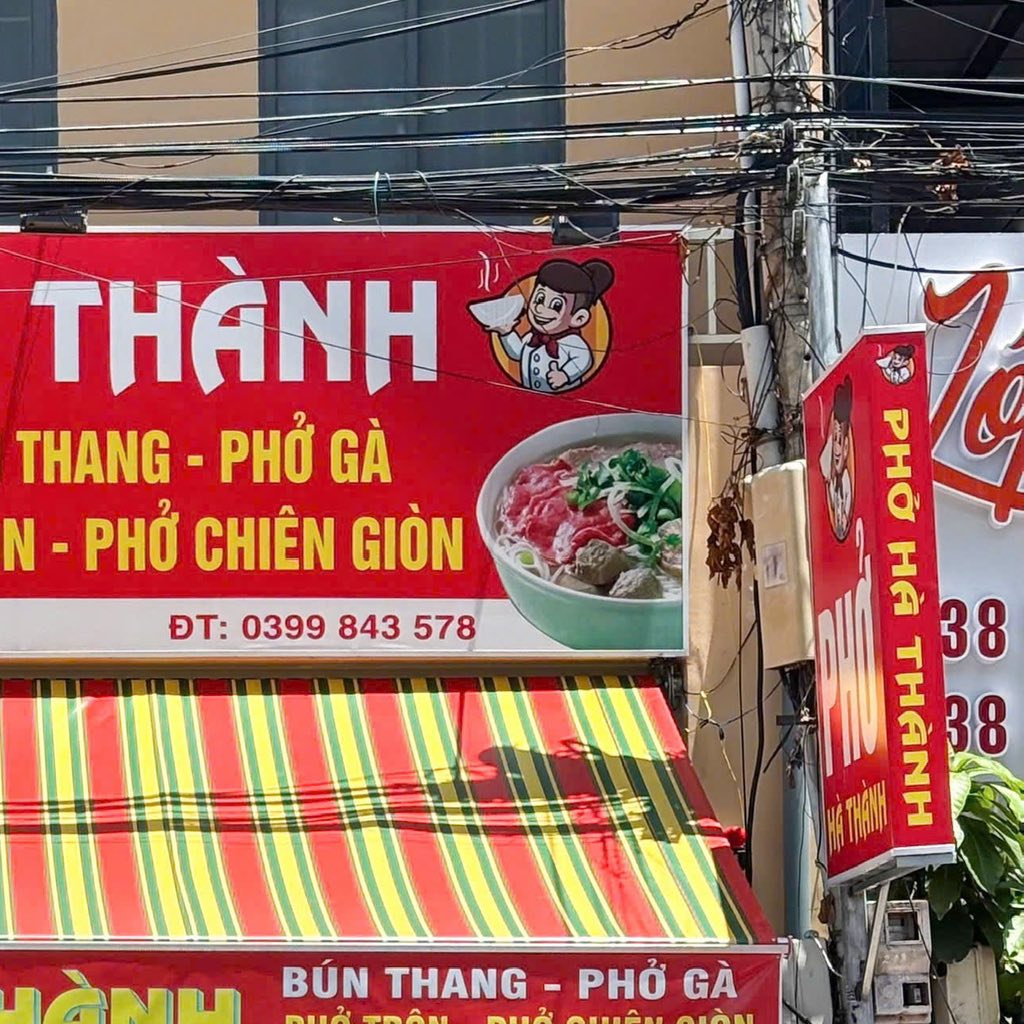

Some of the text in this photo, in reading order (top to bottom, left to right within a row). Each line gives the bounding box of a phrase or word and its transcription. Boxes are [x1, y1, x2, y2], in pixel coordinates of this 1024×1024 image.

[31, 256, 438, 396] THÀNH
[16, 428, 171, 485] THANG
[220, 411, 314, 485] PHỞ
[329, 418, 392, 485] GÀ
[85, 499, 180, 572] PHỞ
[194, 504, 336, 572] CHIÊN
[353, 503, 464, 572] GIÒN
[168, 613, 476, 641] ĐT: 0399 843 578
[818, 517, 878, 778] PHỞ
[881, 407, 934, 828] PHỞ HÀ THÀNH
[827, 779, 888, 858] HÀ THÀNH
[282, 958, 369, 999] BÚN
[384, 967, 527, 1000] THANG
[578, 957, 667, 1001] PHỞ
[683, 959, 738, 1001] GÀ
